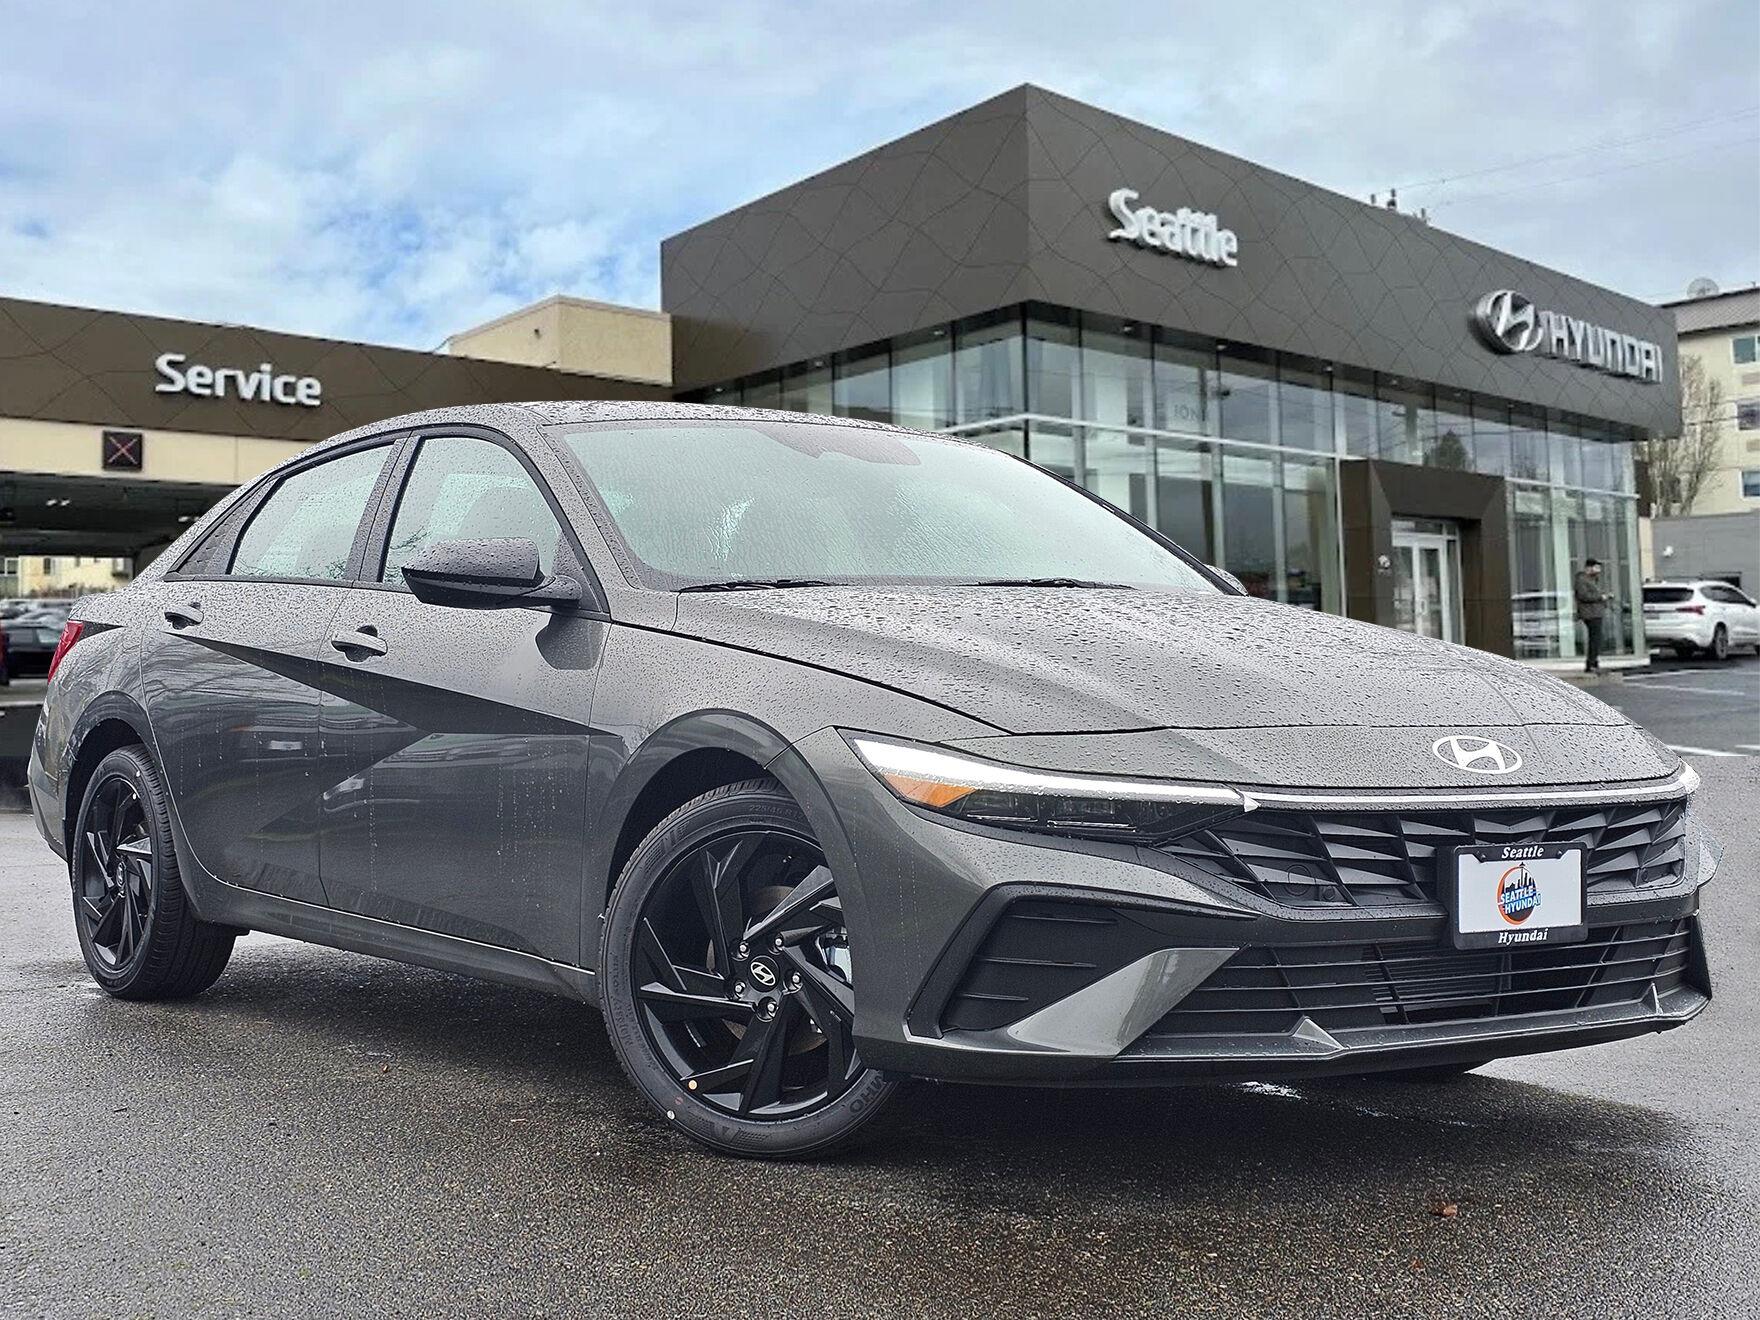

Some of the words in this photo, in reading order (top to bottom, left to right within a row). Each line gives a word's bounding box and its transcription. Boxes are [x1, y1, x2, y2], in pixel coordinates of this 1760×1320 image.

[1108, 187, 1238, 267] Seattle
[1540, 311, 1663, 383] HYUNDAI
[155, 352, 322, 406] Service
[1501, 845, 1544, 859] Seattle
[1500, 885, 1537, 905] SEATTLE
[1504, 891, 1542, 914] HYUNDAI
[1498, 928, 1549, 946] Hyundai
[850, 1075, 882, 1113] MHO
